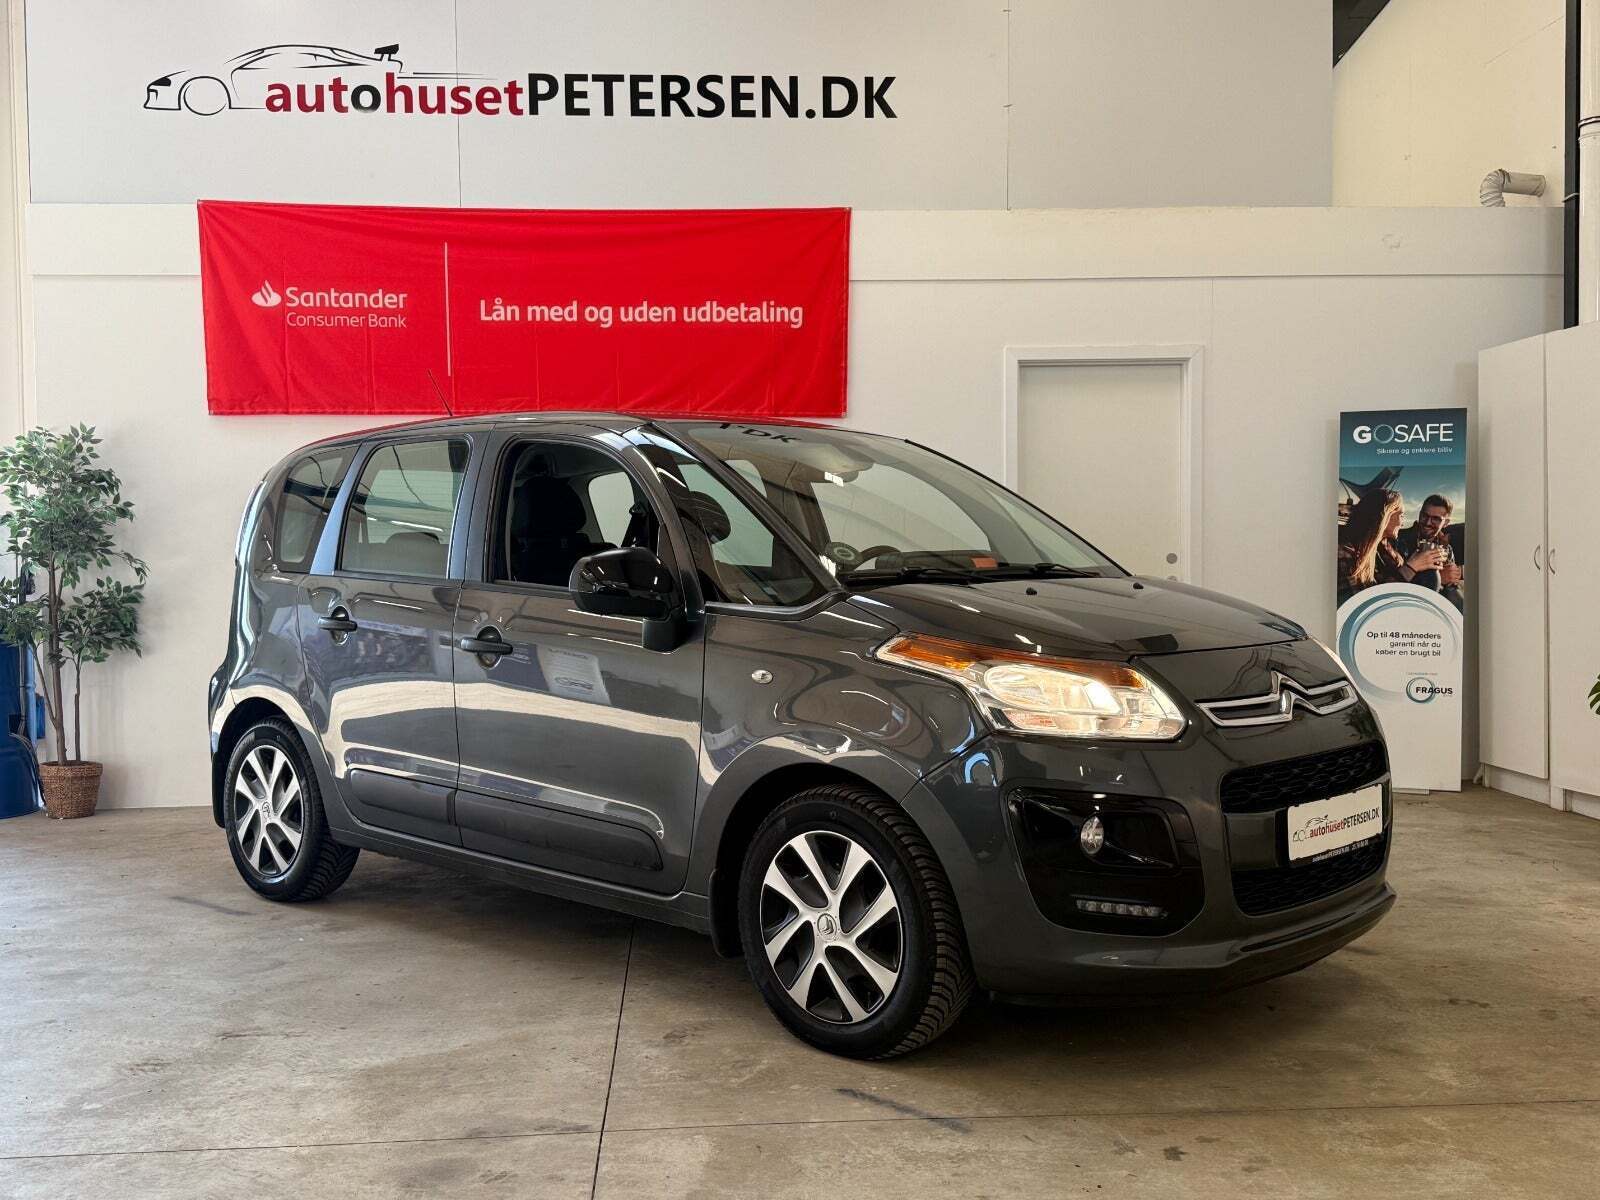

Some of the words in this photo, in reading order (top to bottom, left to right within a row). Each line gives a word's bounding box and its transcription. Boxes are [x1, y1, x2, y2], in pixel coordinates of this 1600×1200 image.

[264, 72, 898, 119] autohusetPETERSEN.DK
[285, 286, 408, 309] Santander
[286, 311, 365, 328] Consumer
[368, 313, 407, 328] Bank
[480, 297, 520, 322] Lån
[527, 300, 578, 322] med
[584, 304, 613, 328] og
[620, 300, 677, 323] uden
[683, 301, 804, 329] udbetaling
[1353, 423, 1454, 444] GOSAFE
[1366, 631, 1379, 639] Op
[1401, 631, 1442, 639] måneders
[1389, 641, 1415, 649] garanti
[1417, 640, 1430, 648] når
[1375, 648, 1397, 656] køber
[1410, 649, 1430, 658] brugt
[1432, 648, 1441, 656] bil
[1415, 686, 1454, 695] FRAGUS
[1309, 807, 1380, 838] autohusetPETERSEN.DK
